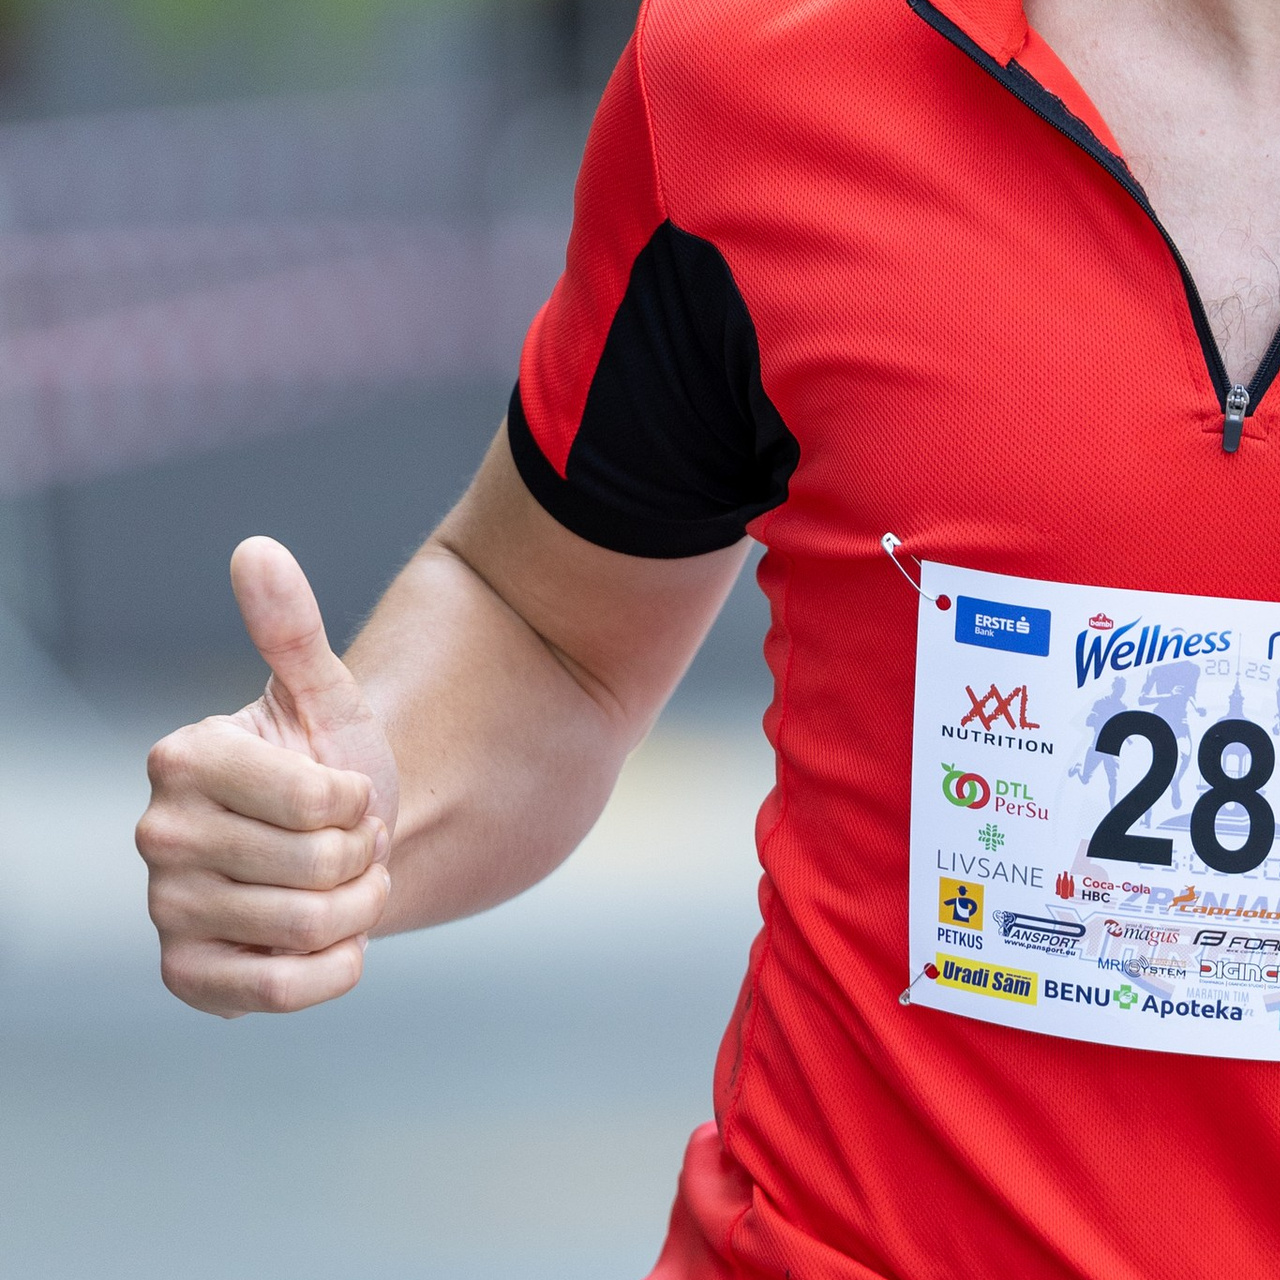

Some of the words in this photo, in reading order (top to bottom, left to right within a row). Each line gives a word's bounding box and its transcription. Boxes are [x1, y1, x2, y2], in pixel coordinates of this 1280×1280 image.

[974, 627, 994, 637] Bank
[975, 614, 1015, 632] ERSTE
[1090, 619, 1112, 628] bambi
[1075, 616, 1232, 689] Wellness
[960, 683, 1041, 732] XXL
[941, 724, 1054, 755] NUTRITION
[995, 779, 1034, 801] DTL
[994, 796, 1050, 821] PerSu
[936, 849, 1044, 889] LIVSANE
[1081, 889, 1111, 904] HBC
[1082, 876, 1151, 895] Coca-Cola
[937, 926, 984, 951] PETKUS
[1004, 938, 1077, 957] www.pansport.eu
[1123, 927, 1181, 947] magus
[942, 960, 990, 988] Uradi
[991, 971, 1032, 997] Sam
[1044, 979, 1110, 1007] BENU
[1186, 986, 1230, 1002] MARATON
[1233, 990, 1250, 1003] TIM
[1141, 995, 1243, 1021] Apoteka
